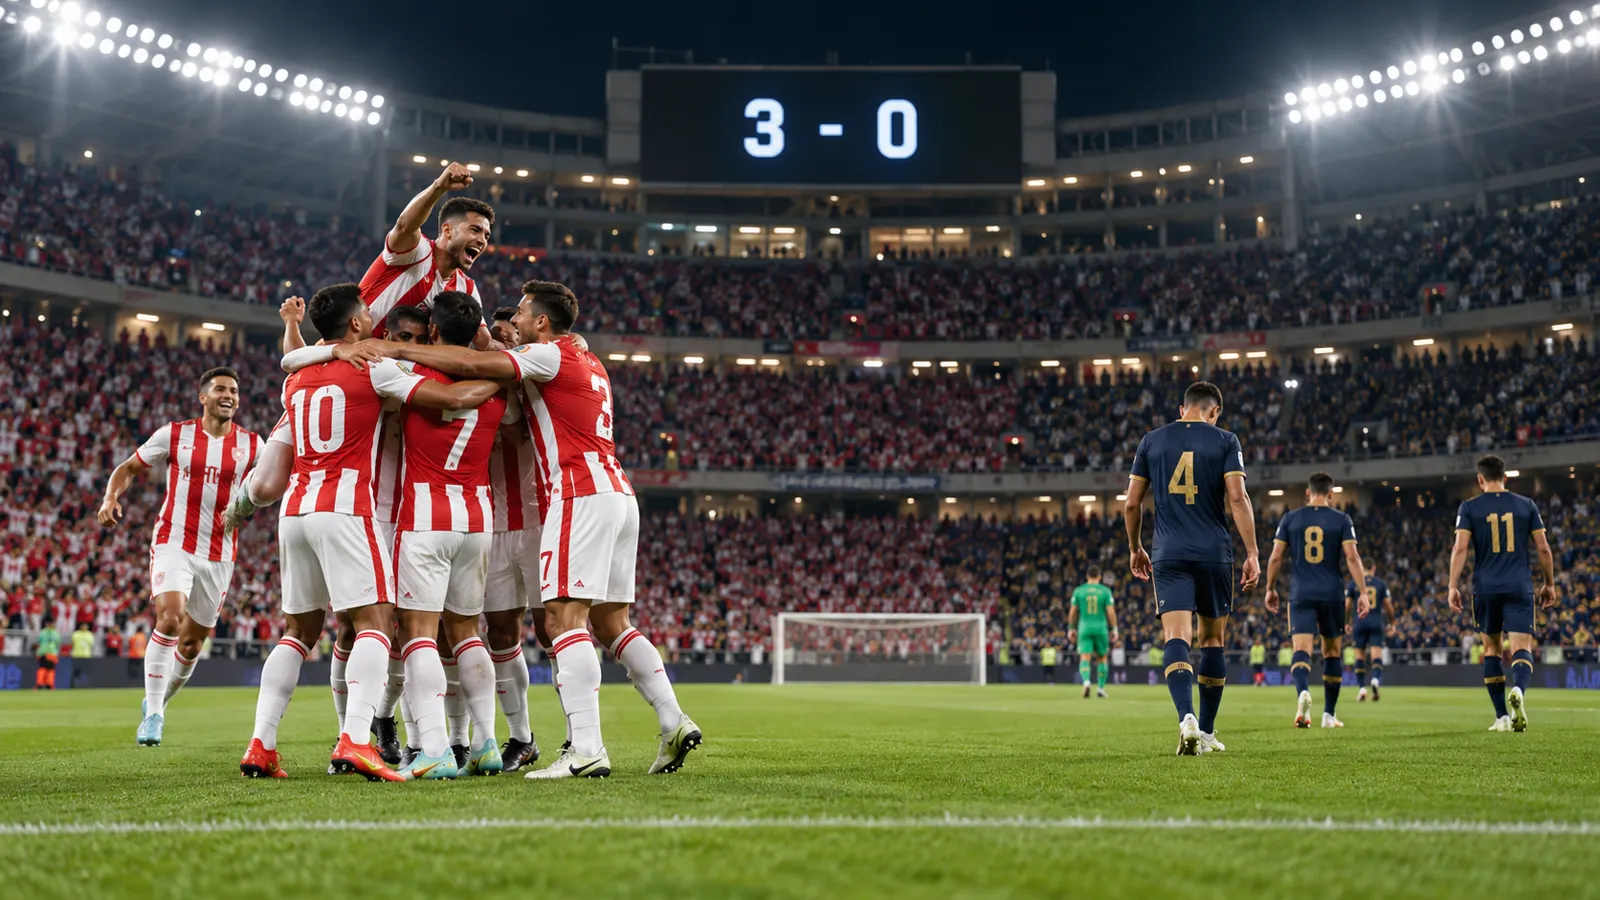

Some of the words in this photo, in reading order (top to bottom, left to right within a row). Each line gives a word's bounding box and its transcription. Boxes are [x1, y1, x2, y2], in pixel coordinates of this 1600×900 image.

[744, 98, 785, 158] 3
[876, 99, 918, 159] 0
[291, 384, 347, 457] 10
[442, 408, 479, 470] 7
[1168, 451, 1199, 505] 4
[1304, 525, 1324, 564] 8
[1486, 512, 1515, 553] 11
[540, 550, 553, 581] 7
[1086, 595, 1098, 615] 11
